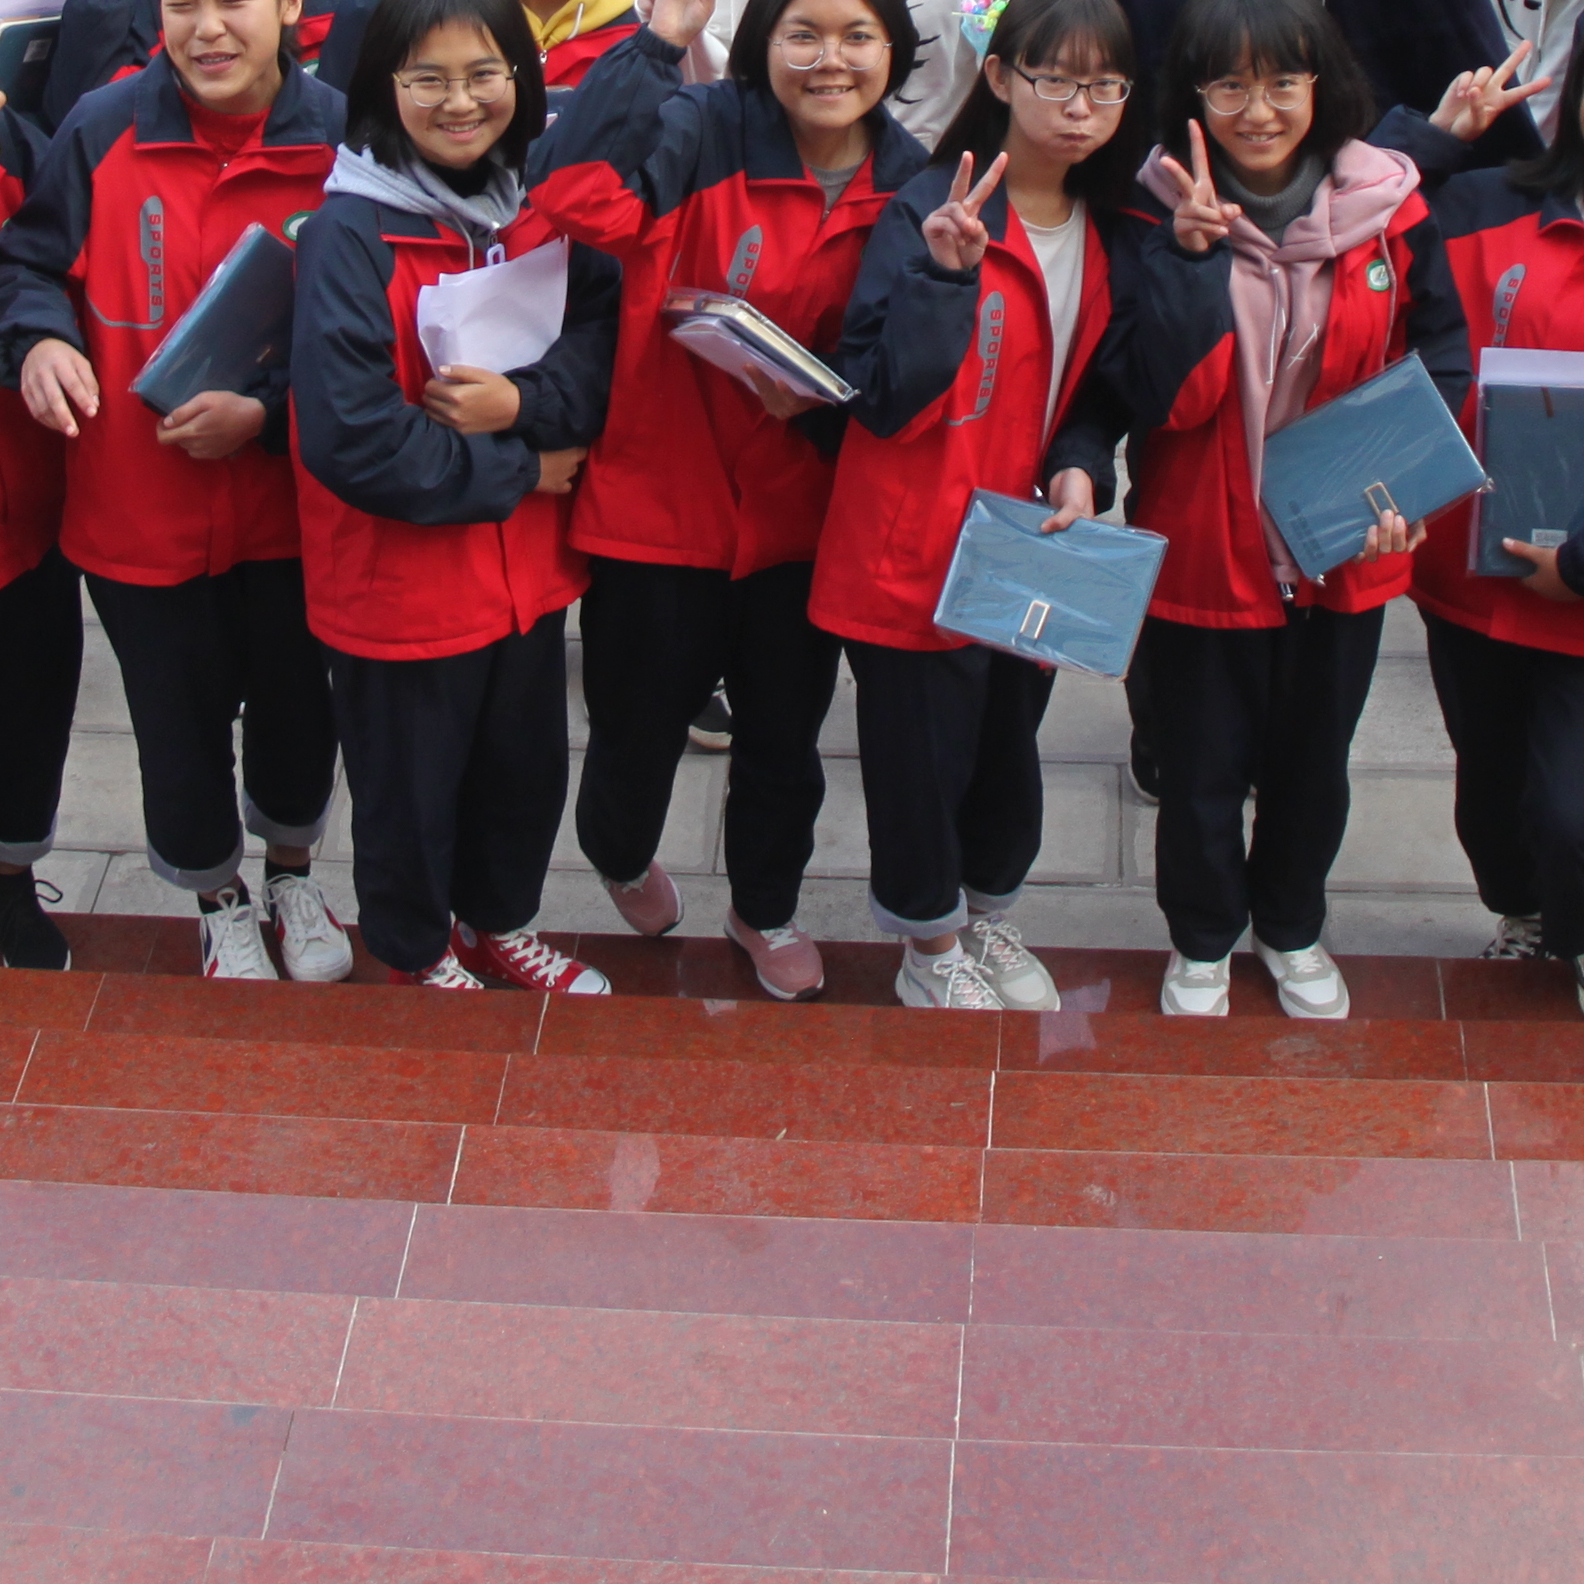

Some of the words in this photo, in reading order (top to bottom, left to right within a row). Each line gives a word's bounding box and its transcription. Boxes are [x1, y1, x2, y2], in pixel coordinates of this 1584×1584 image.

[149, 214, 164, 306] SPORTS
[732, 242, 761, 297] SPOR
[979, 309, 1003, 398] SPORTS
